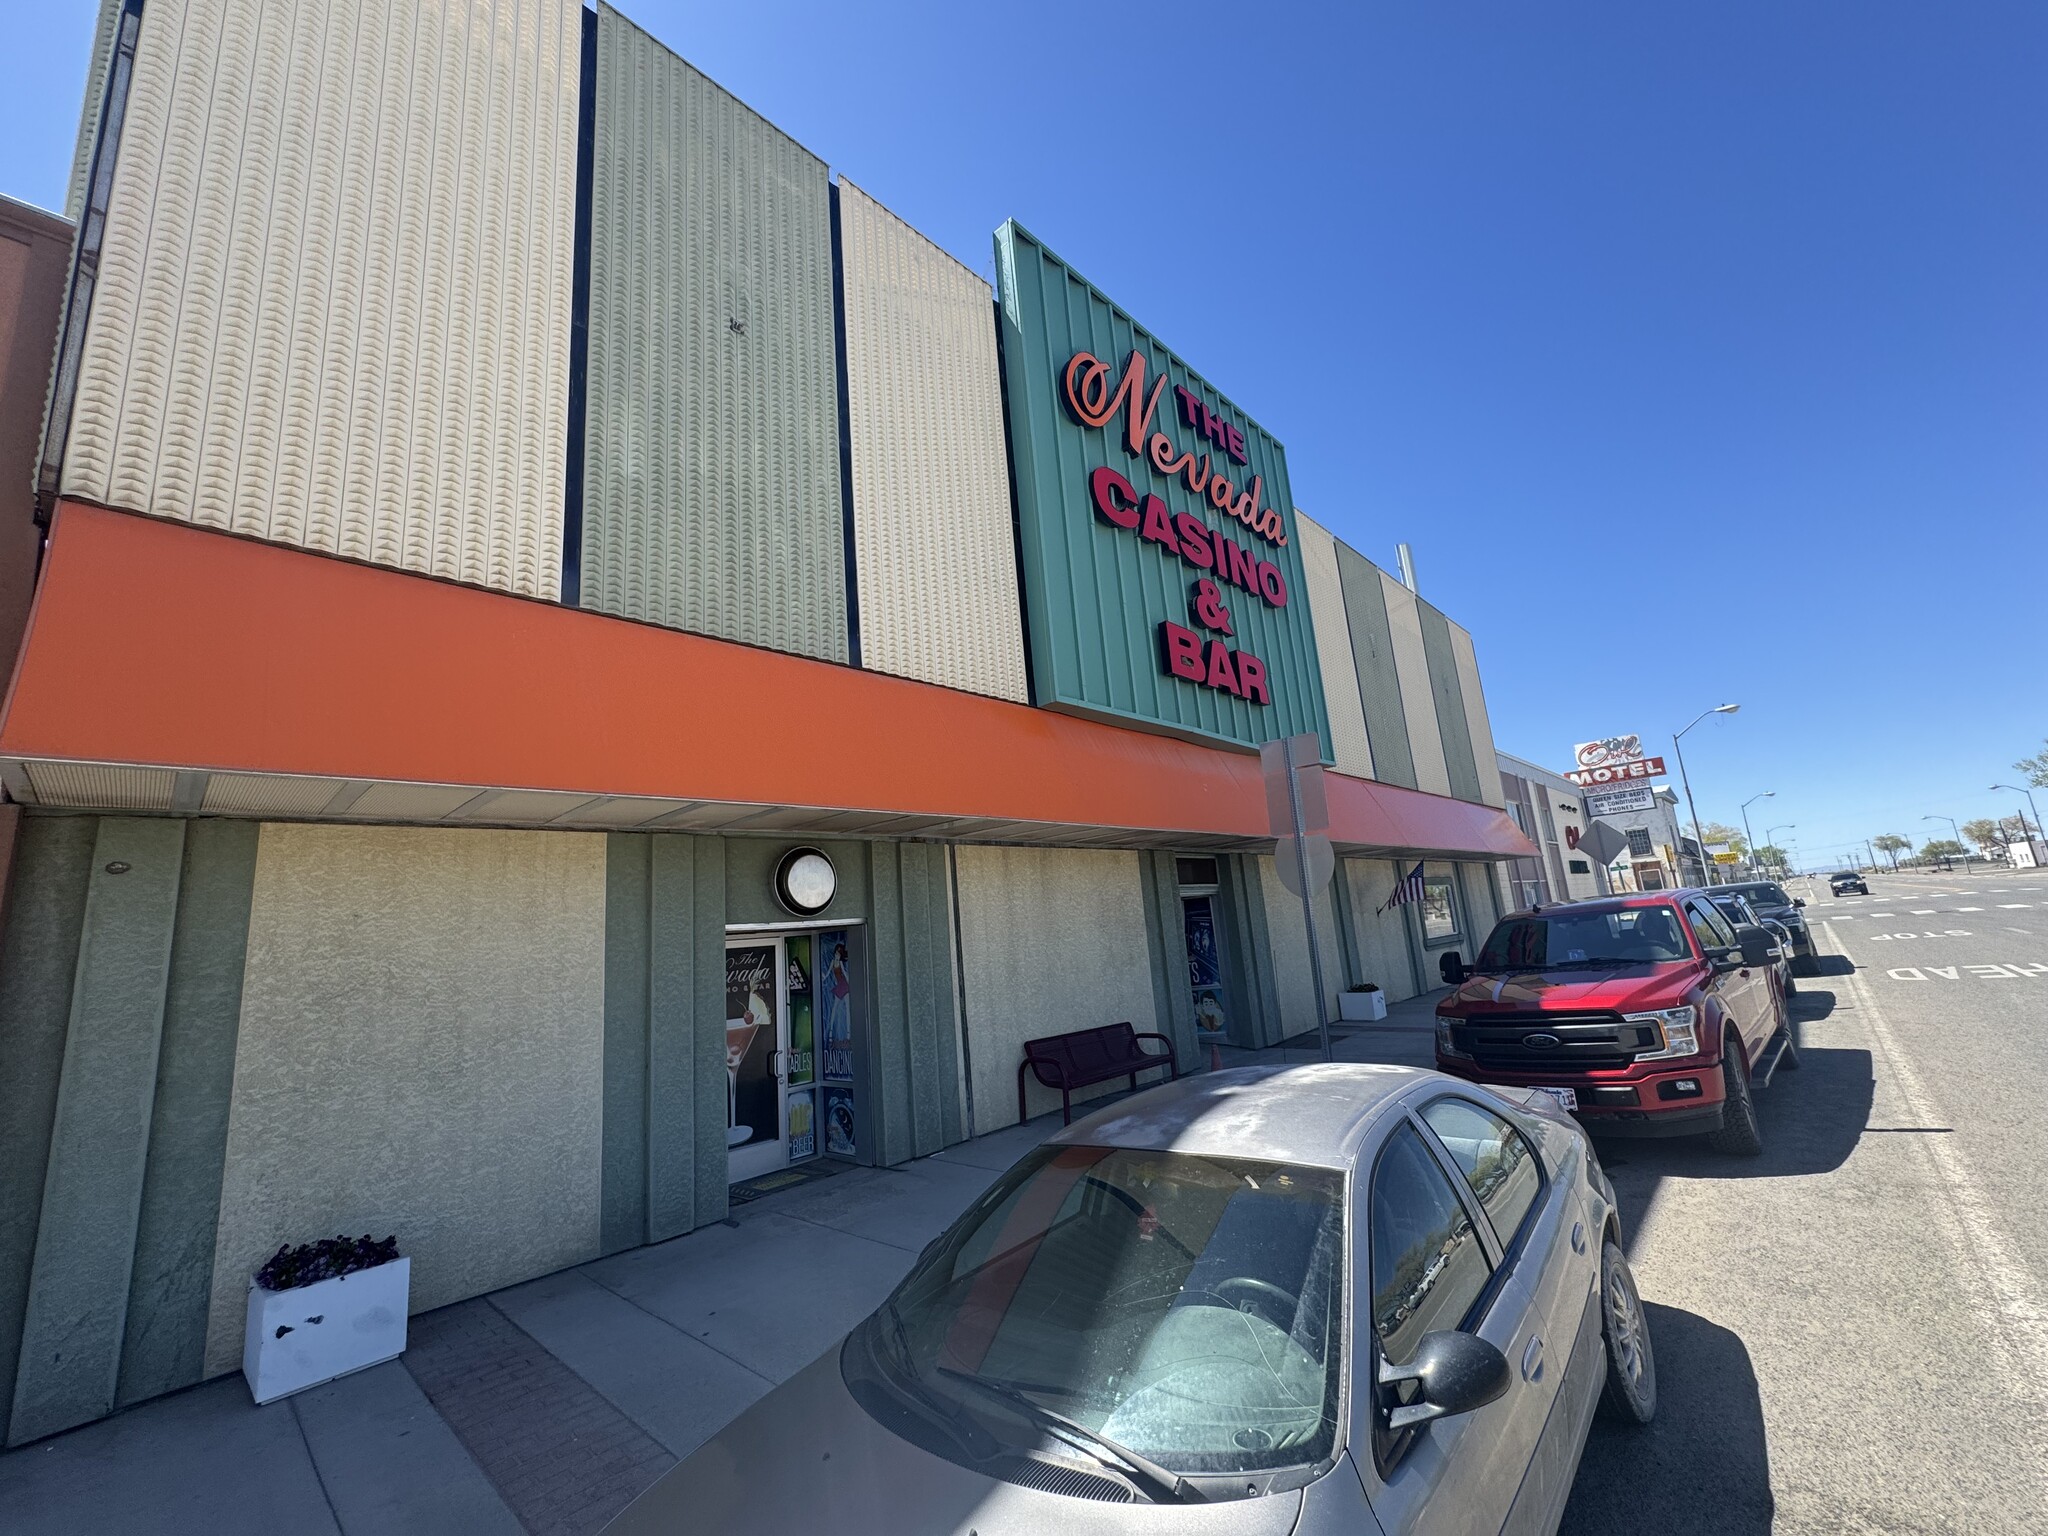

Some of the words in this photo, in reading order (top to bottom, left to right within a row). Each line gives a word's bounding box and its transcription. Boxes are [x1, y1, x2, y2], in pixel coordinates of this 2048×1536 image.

[1173, 384, 1247, 466] THE
[1060, 350, 1288, 548] Nevada
[1090, 466, 1288, 608] CASINO
[1190, 577, 1235, 638] &
[1158, 620, 1271, 706] BAR
[1578, 736, 1642, 767] Owl
[1569, 760, 1662, 786] MOTEL
[1593, 795, 1612, 803] QUEEN
[1607, 796, 1647, 807] CONDITIONED
[1608, 804, 1634, 813] PHONES
[1869, 929, 1973, 941] STOP
[726, 953, 771, 984] vada
[736, 951, 758, 965] The
[1886, 962, 2048, 981] HEAD
[792, 1135, 814, 1155] BEER
